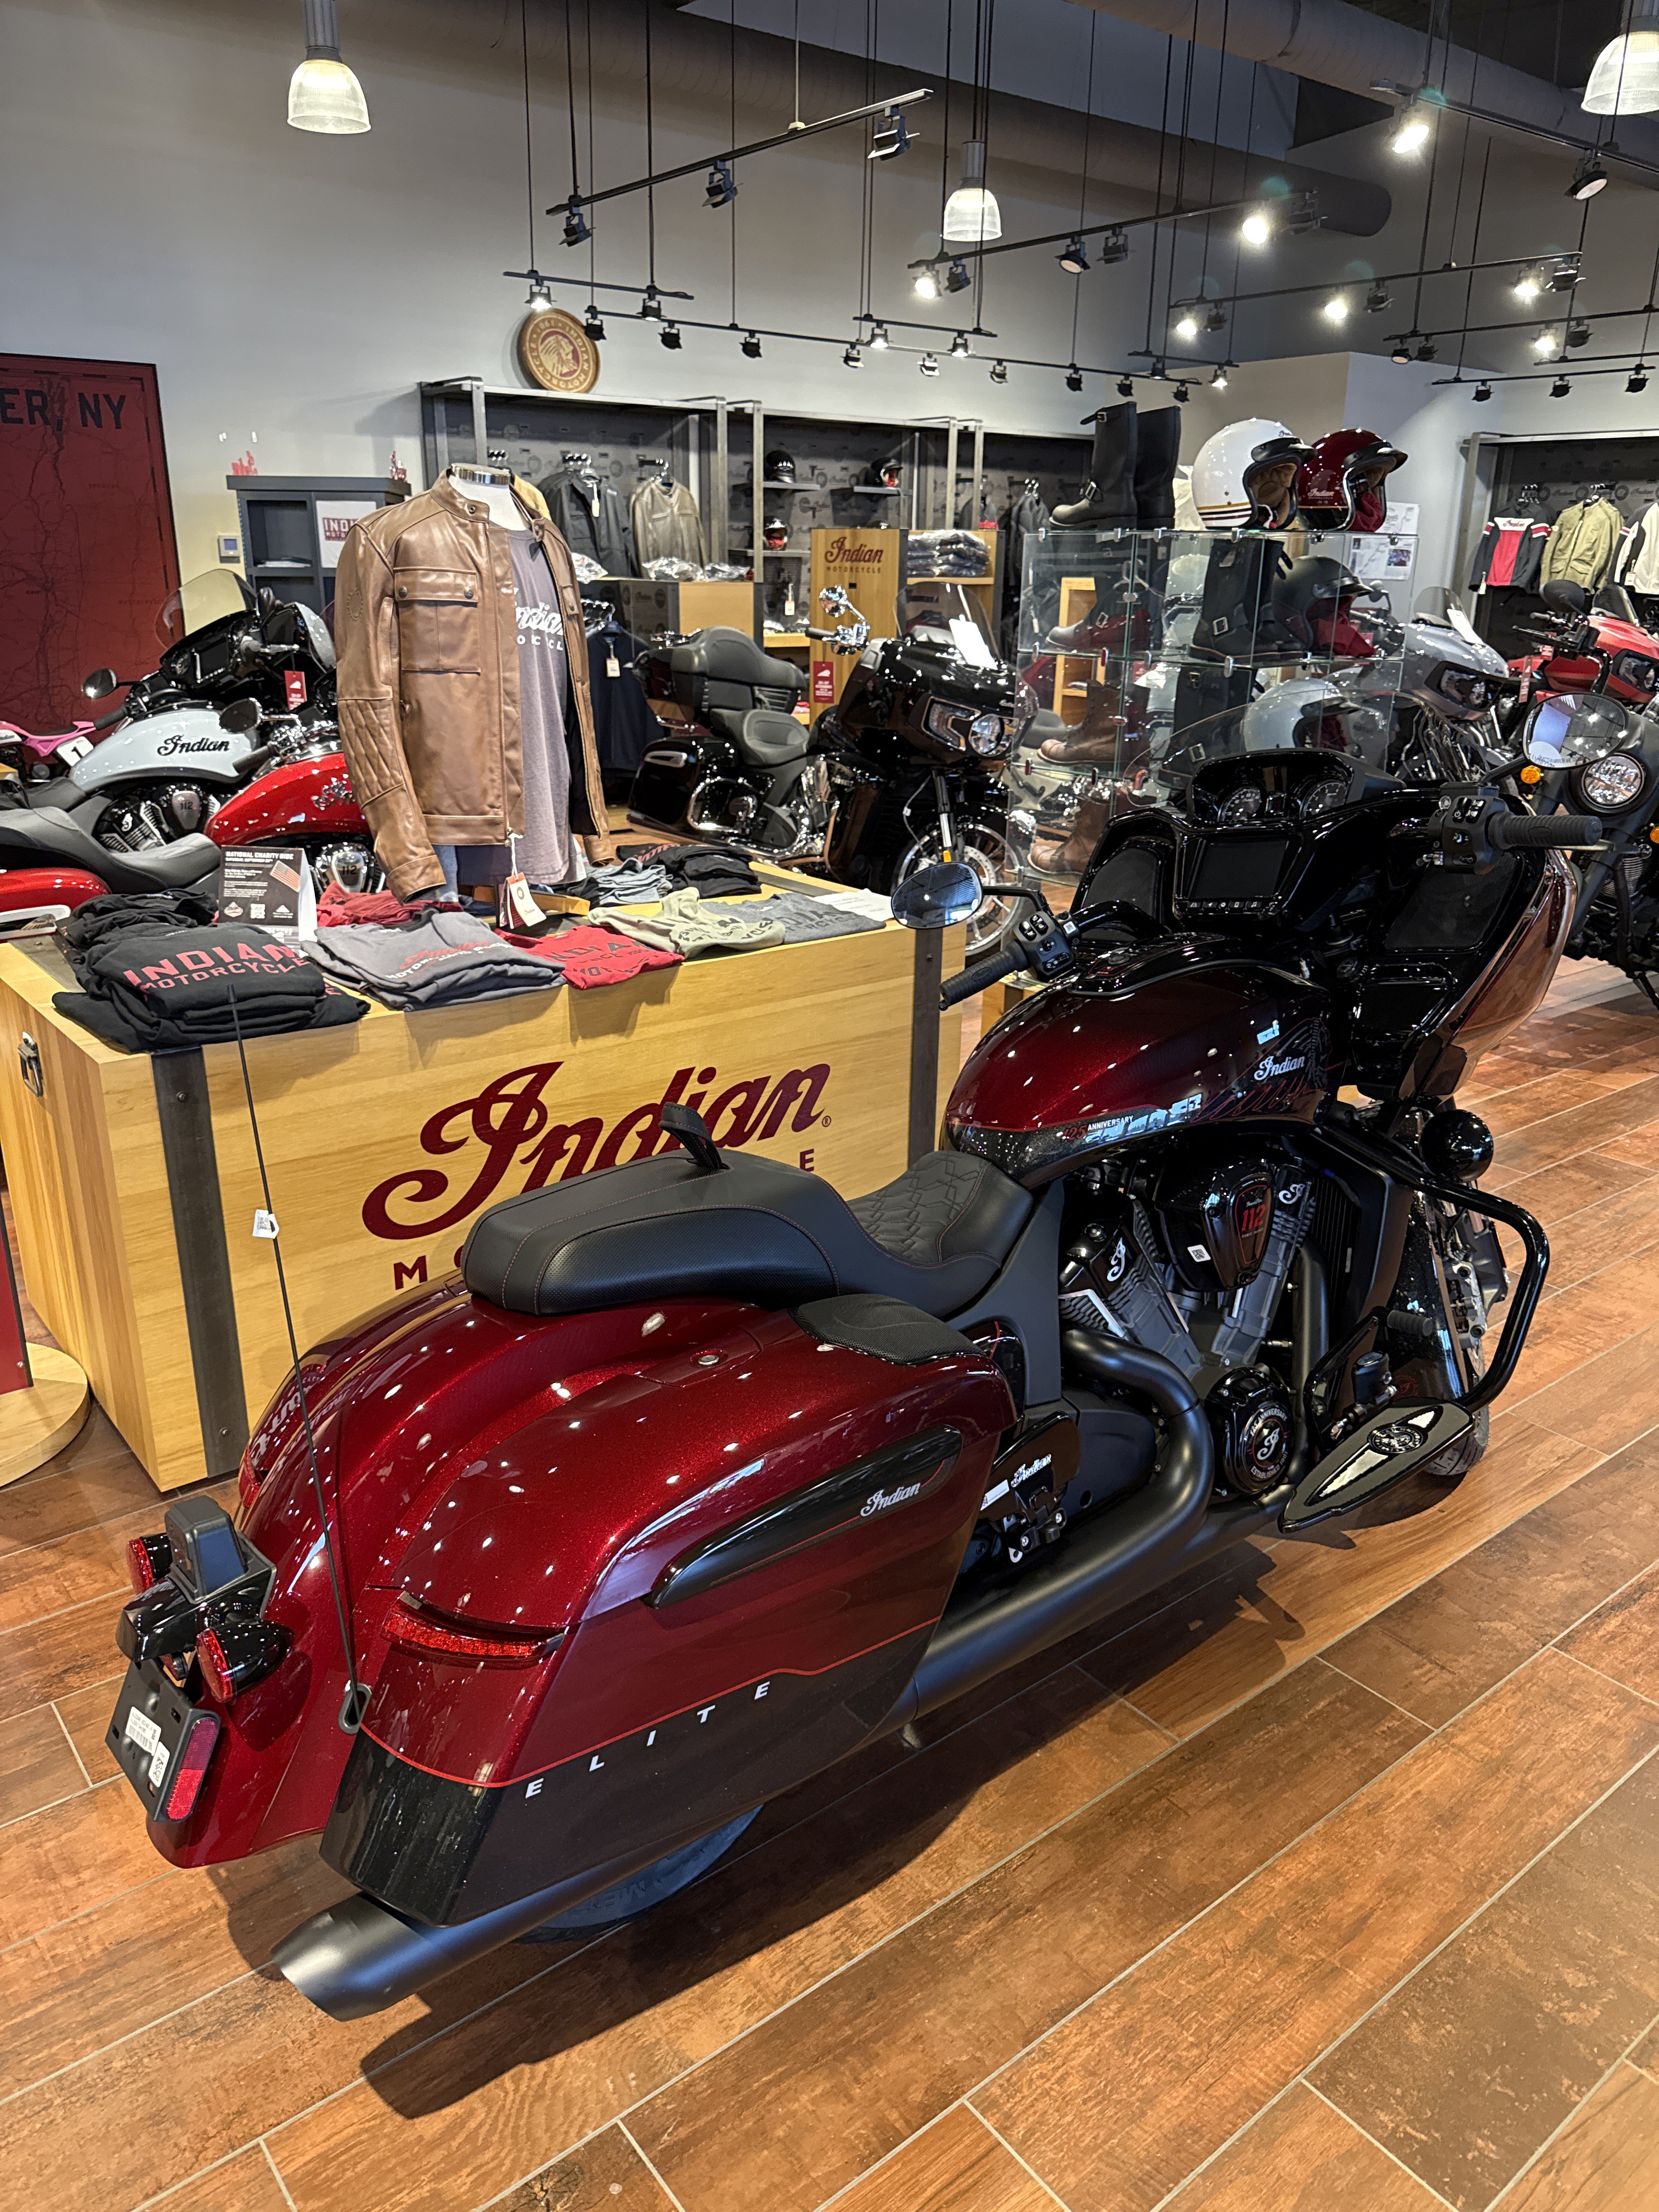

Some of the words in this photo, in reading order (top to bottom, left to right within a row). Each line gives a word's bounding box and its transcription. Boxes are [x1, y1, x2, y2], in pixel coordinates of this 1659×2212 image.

[78, 392, 127, 430] NY
[324, 519, 354, 532] IND
[825, 537, 883, 563] Indian
[516, 601, 563, 636] ndia
[157, 735, 230, 756] Indian
[180, 802, 194, 810] 112
[342, 865, 357, 875] 112
[123, 943, 297, 986] INDIAN
[139, 957, 311, 993] MOTORCYCLE
[1254, 1056, 1305, 1080] Indian
[1088, 1115, 1134, 1131] ANNIVERSARY
[1242, 1204, 1266, 1231] 112
[1258, 1408, 1288, 1422] ANNIVERSARY
[1250, 1464, 1280, 1479] ESTABLISHED
[860, 1483, 921, 1516] Indian
[526, 1681, 770, 1799] ELITE
